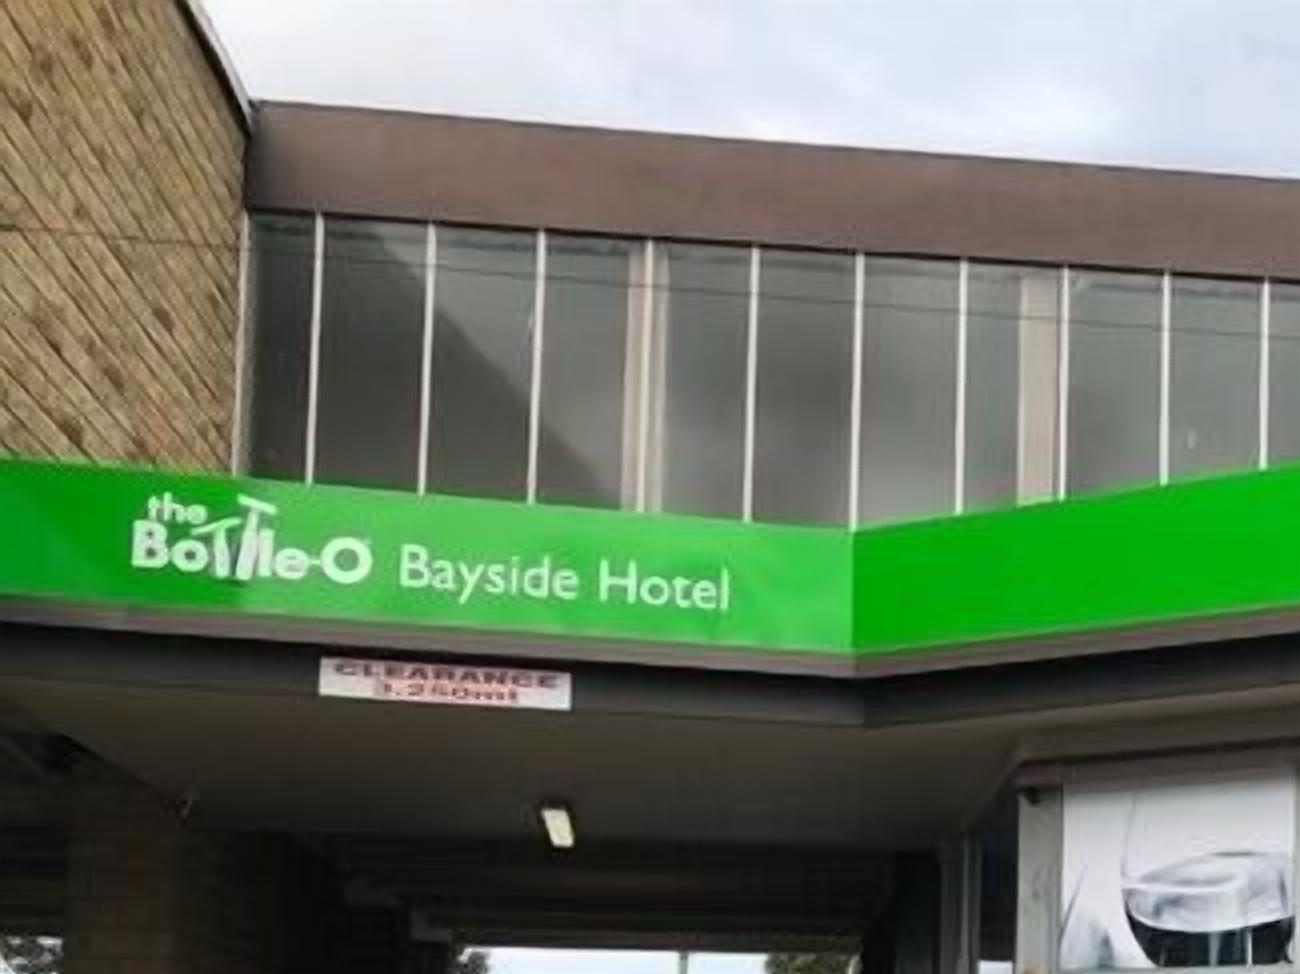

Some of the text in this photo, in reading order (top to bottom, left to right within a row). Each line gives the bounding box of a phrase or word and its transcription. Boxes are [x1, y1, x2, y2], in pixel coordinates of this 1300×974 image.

[131, 494, 373, 584] Bottle-O
[148, 491, 208, 526] the
[399, 543, 731, 611] Bayside Hotel
